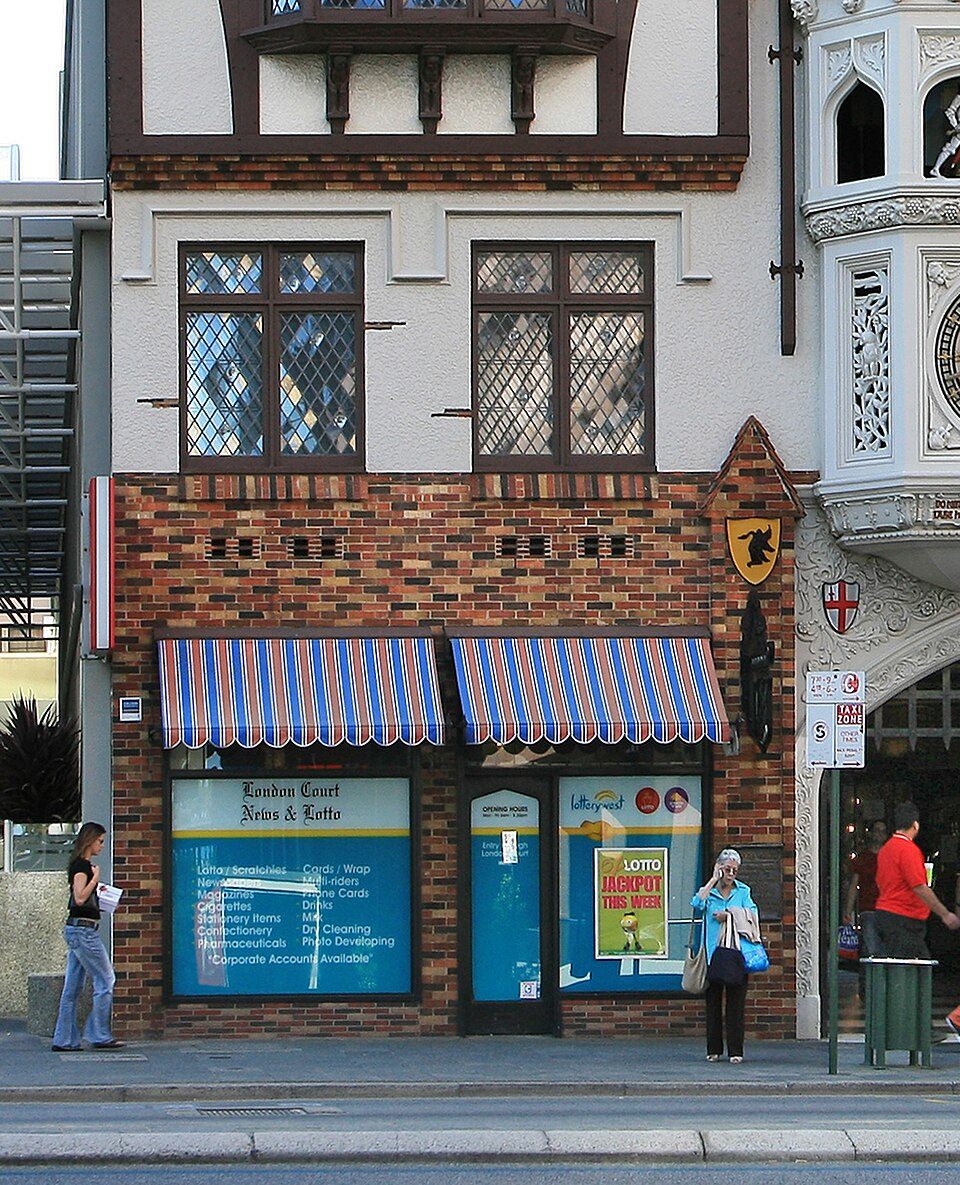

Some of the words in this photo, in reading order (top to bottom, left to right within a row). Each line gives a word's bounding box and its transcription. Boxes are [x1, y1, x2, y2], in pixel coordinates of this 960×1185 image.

[839, 705, 862, 714] TAXI
[837, 715, 863, 724] ZONE
[242, 781, 296, 803] London
[300, 781, 340, 798] Court
[570, 794, 625, 814] lotterywest
[240, 804, 280, 826] News
[284, 805, 297, 822] &
[302, 804, 341, 826] Lotto
[197, 865, 223, 875] Lotto
[232, 865, 287, 875] Scratchies
[303, 864, 334, 874] Cards
[343, 864, 371, 876] Wrap
[624, 859, 662, 872] LOTTO
[302, 876, 360, 886] Multi-riders
[601, 875, 662, 893] JACKPOT
[197, 889, 255, 902] Magazines
[338, 888, 370, 898] Cards
[197, 901, 252, 913] Cigarettes
[302, 900, 333, 910] Drinks
[602, 896, 628, 909] THIS
[631, 896, 662, 909] WEEK
[197, 913, 250, 926] Stationery
[252, 913, 281, 923] Items
[302, 912, 323, 922] Mik
[197, 925, 272, 937] Confectionery
[323, 923, 371, 936] Cleaning
[197, 937, 287, 949] Pharmaceuticals
[302, 936, 332, 946] Photo
[335, 936, 395, 948] Developing
